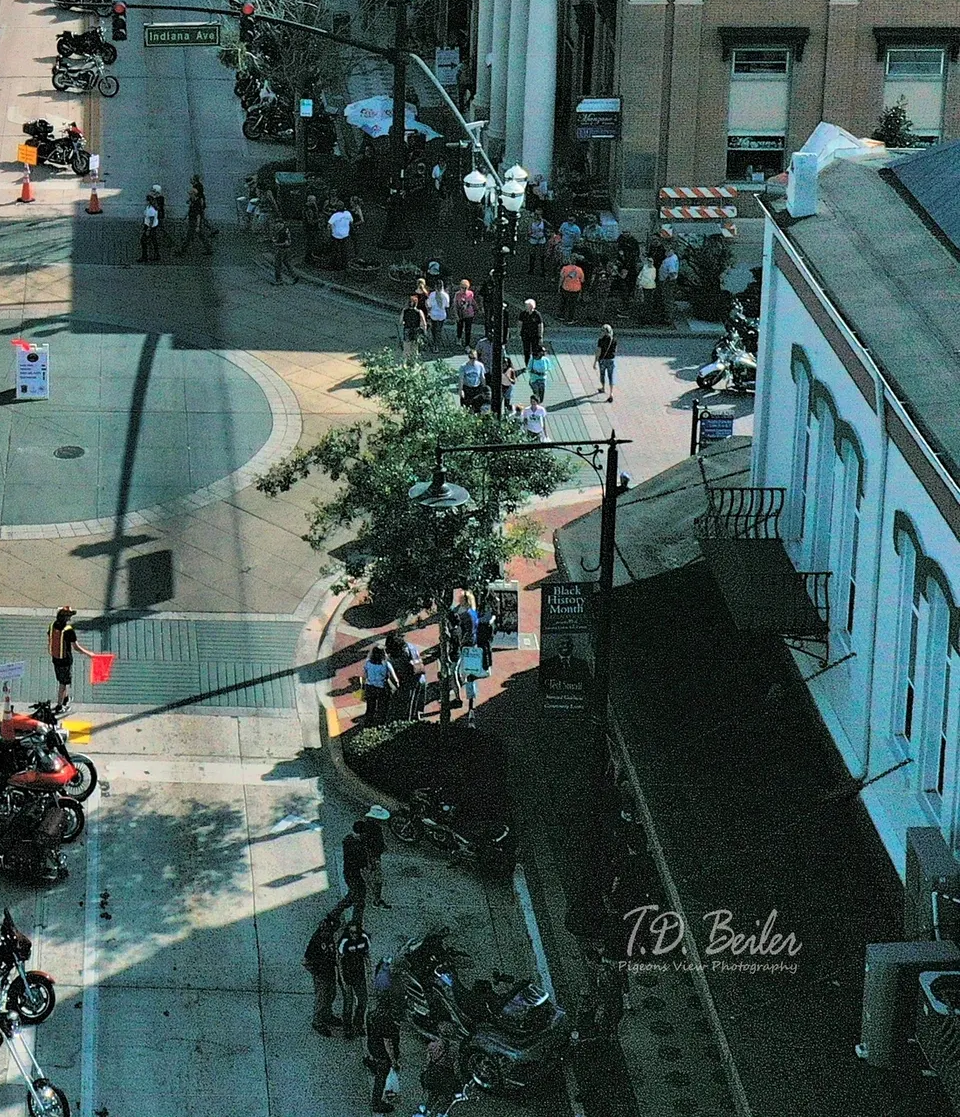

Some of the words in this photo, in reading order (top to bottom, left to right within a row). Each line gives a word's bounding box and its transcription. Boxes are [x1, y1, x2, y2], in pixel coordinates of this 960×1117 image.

[149, 31, 190, 41] Indiana
[196, 30, 215, 40] Ave
[553, 585, 581, 595] Black
[547, 595, 586, 606] History
[549, 604, 584, 614] Month
